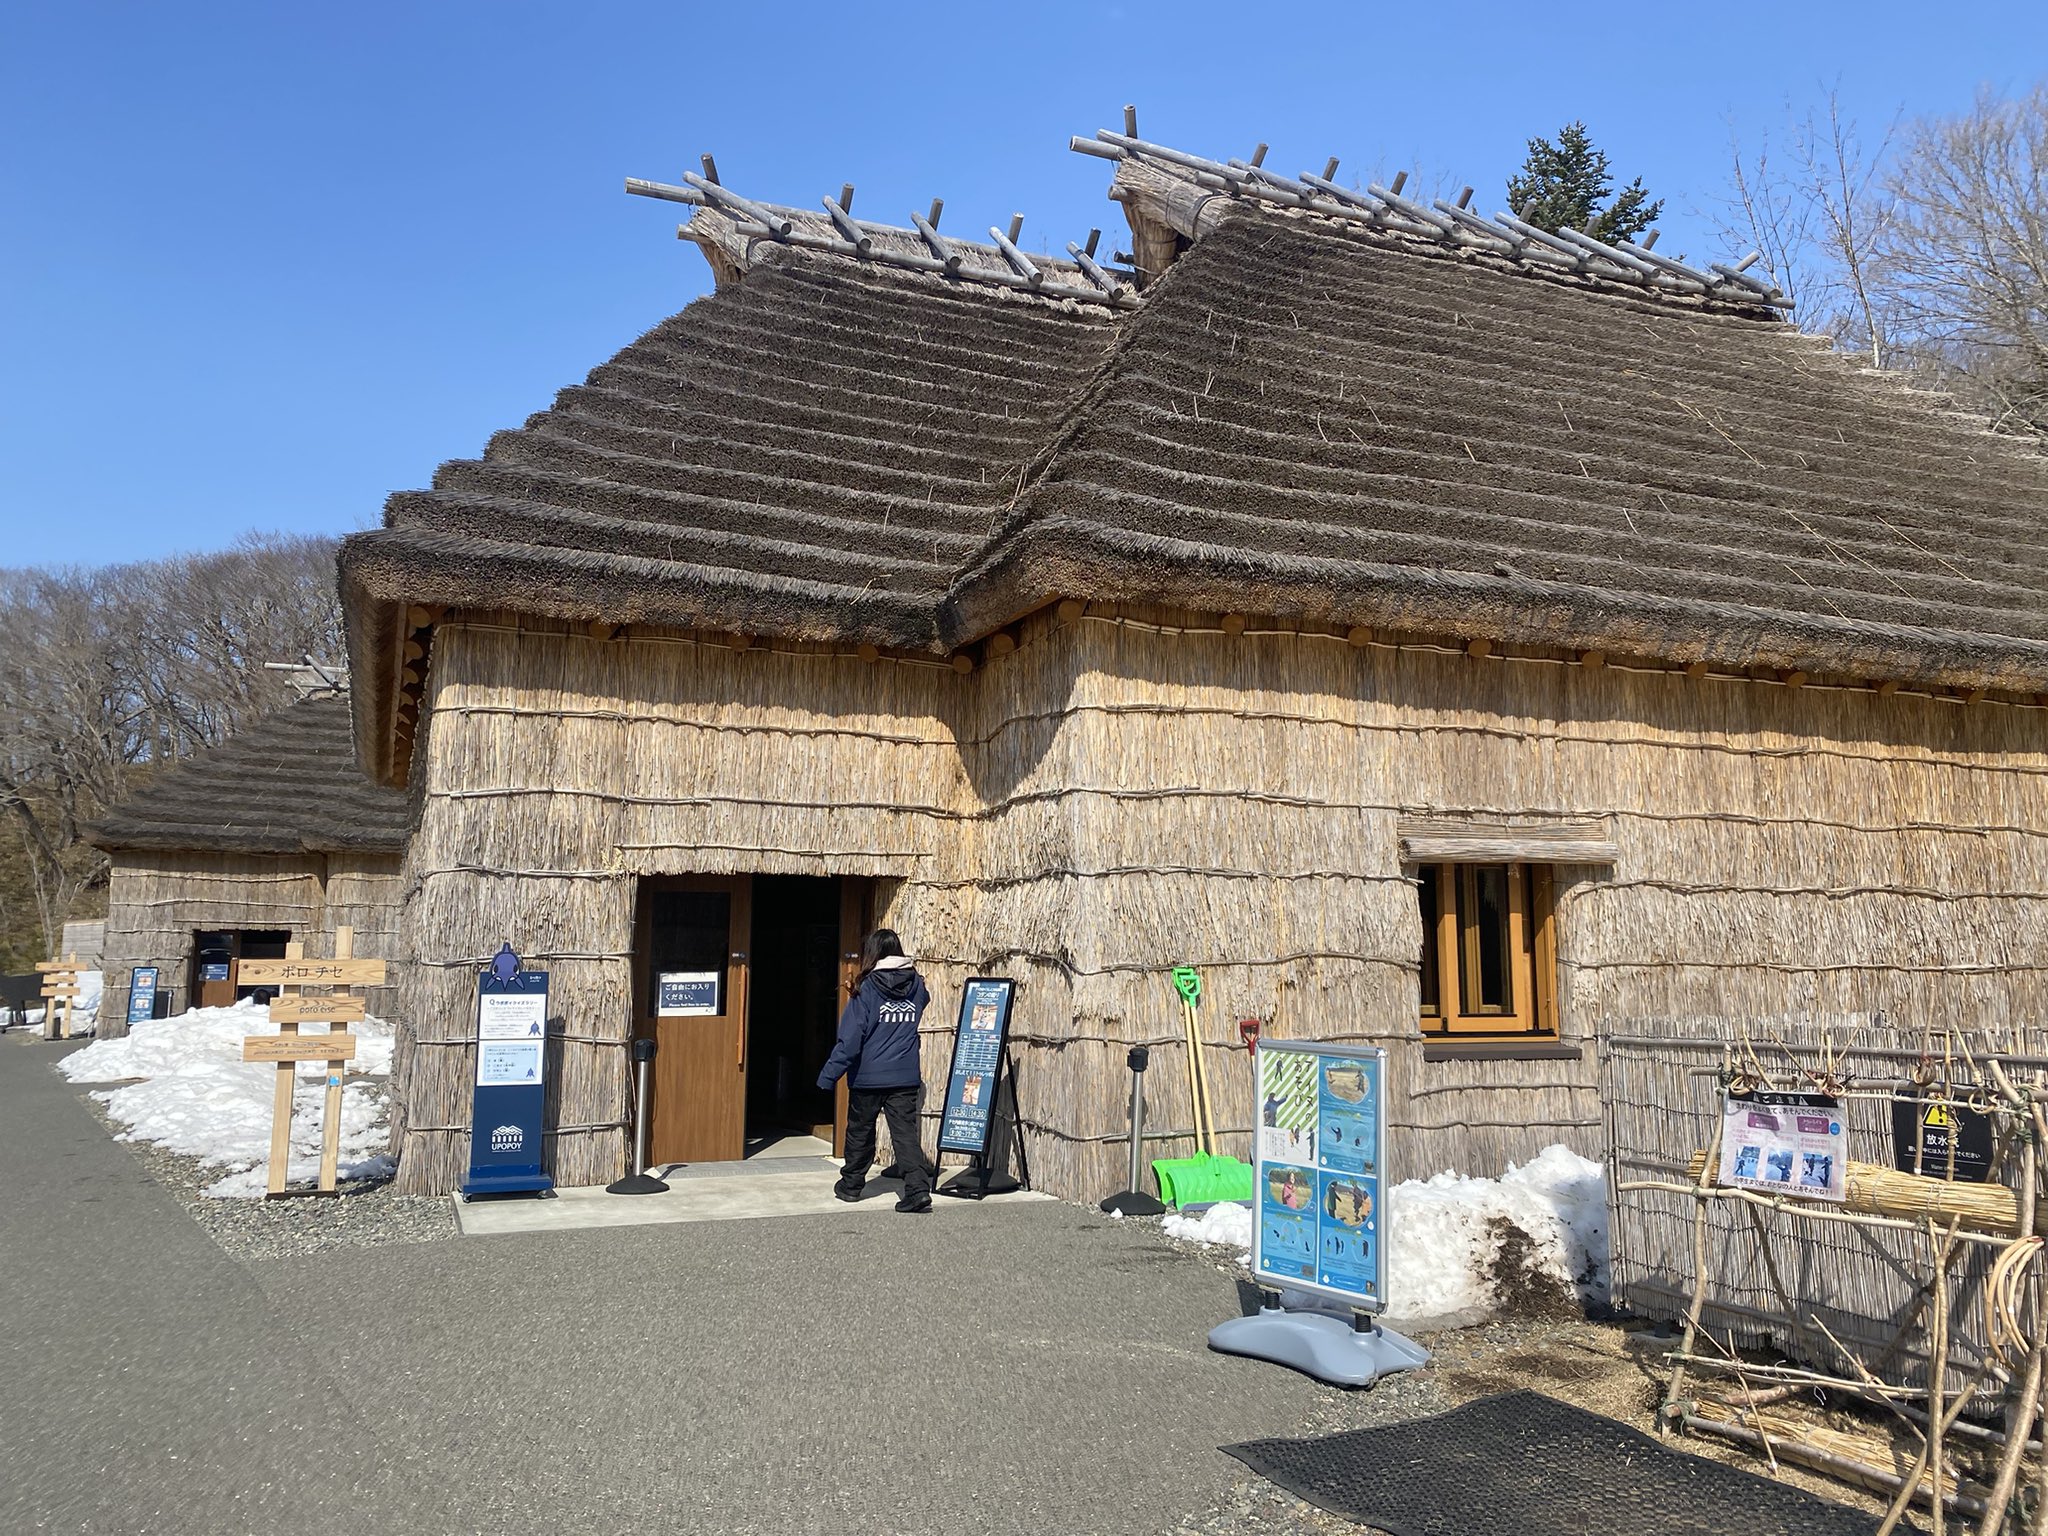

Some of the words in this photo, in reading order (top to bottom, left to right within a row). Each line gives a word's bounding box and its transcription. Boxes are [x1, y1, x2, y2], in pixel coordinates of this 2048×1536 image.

[281, 966, 309, 978] ポロ
[315, 966, 342, 979] チセ
[1294, 1058, 1304, 1108] あそび
[1304, 1060, 1314, 1122] アイヌの
[1762, 1095, 1796, 1105] ご注意
[1735, 1102, 1834, 1118] まわりをよく見て、あそんでください。
[491, 1142, 523, 1151] UPOPOY
